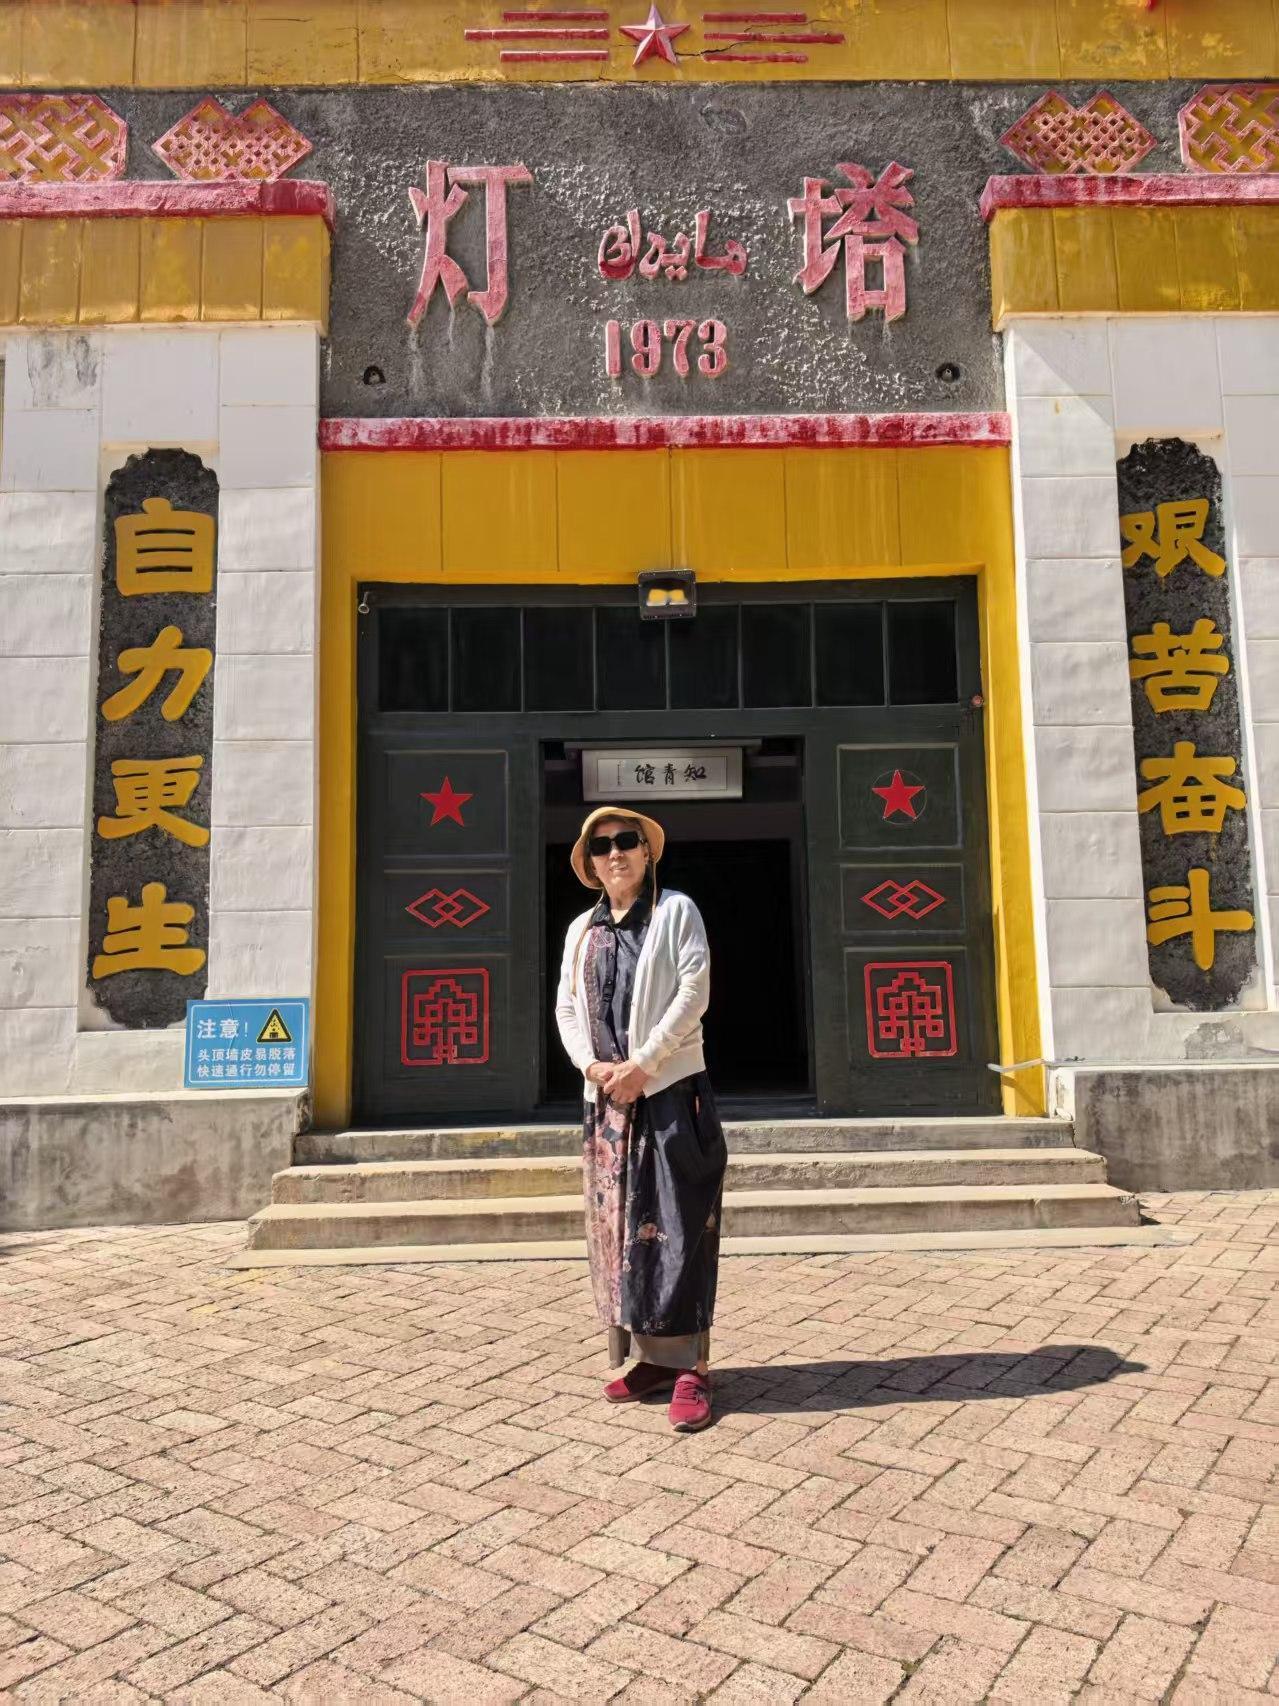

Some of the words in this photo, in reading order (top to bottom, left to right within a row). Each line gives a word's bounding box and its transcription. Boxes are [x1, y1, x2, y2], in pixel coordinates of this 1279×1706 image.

[604, 318, 729, 380] 1973
[93, 496, 214, 980] 自力更生
[1118, 498, 1255, 972] 艰苦奋斗
[197, 1047, 297, 1062] 头顶墙皮易脱落
[197, 1063, 296, 1078] 快速通行勿停留
